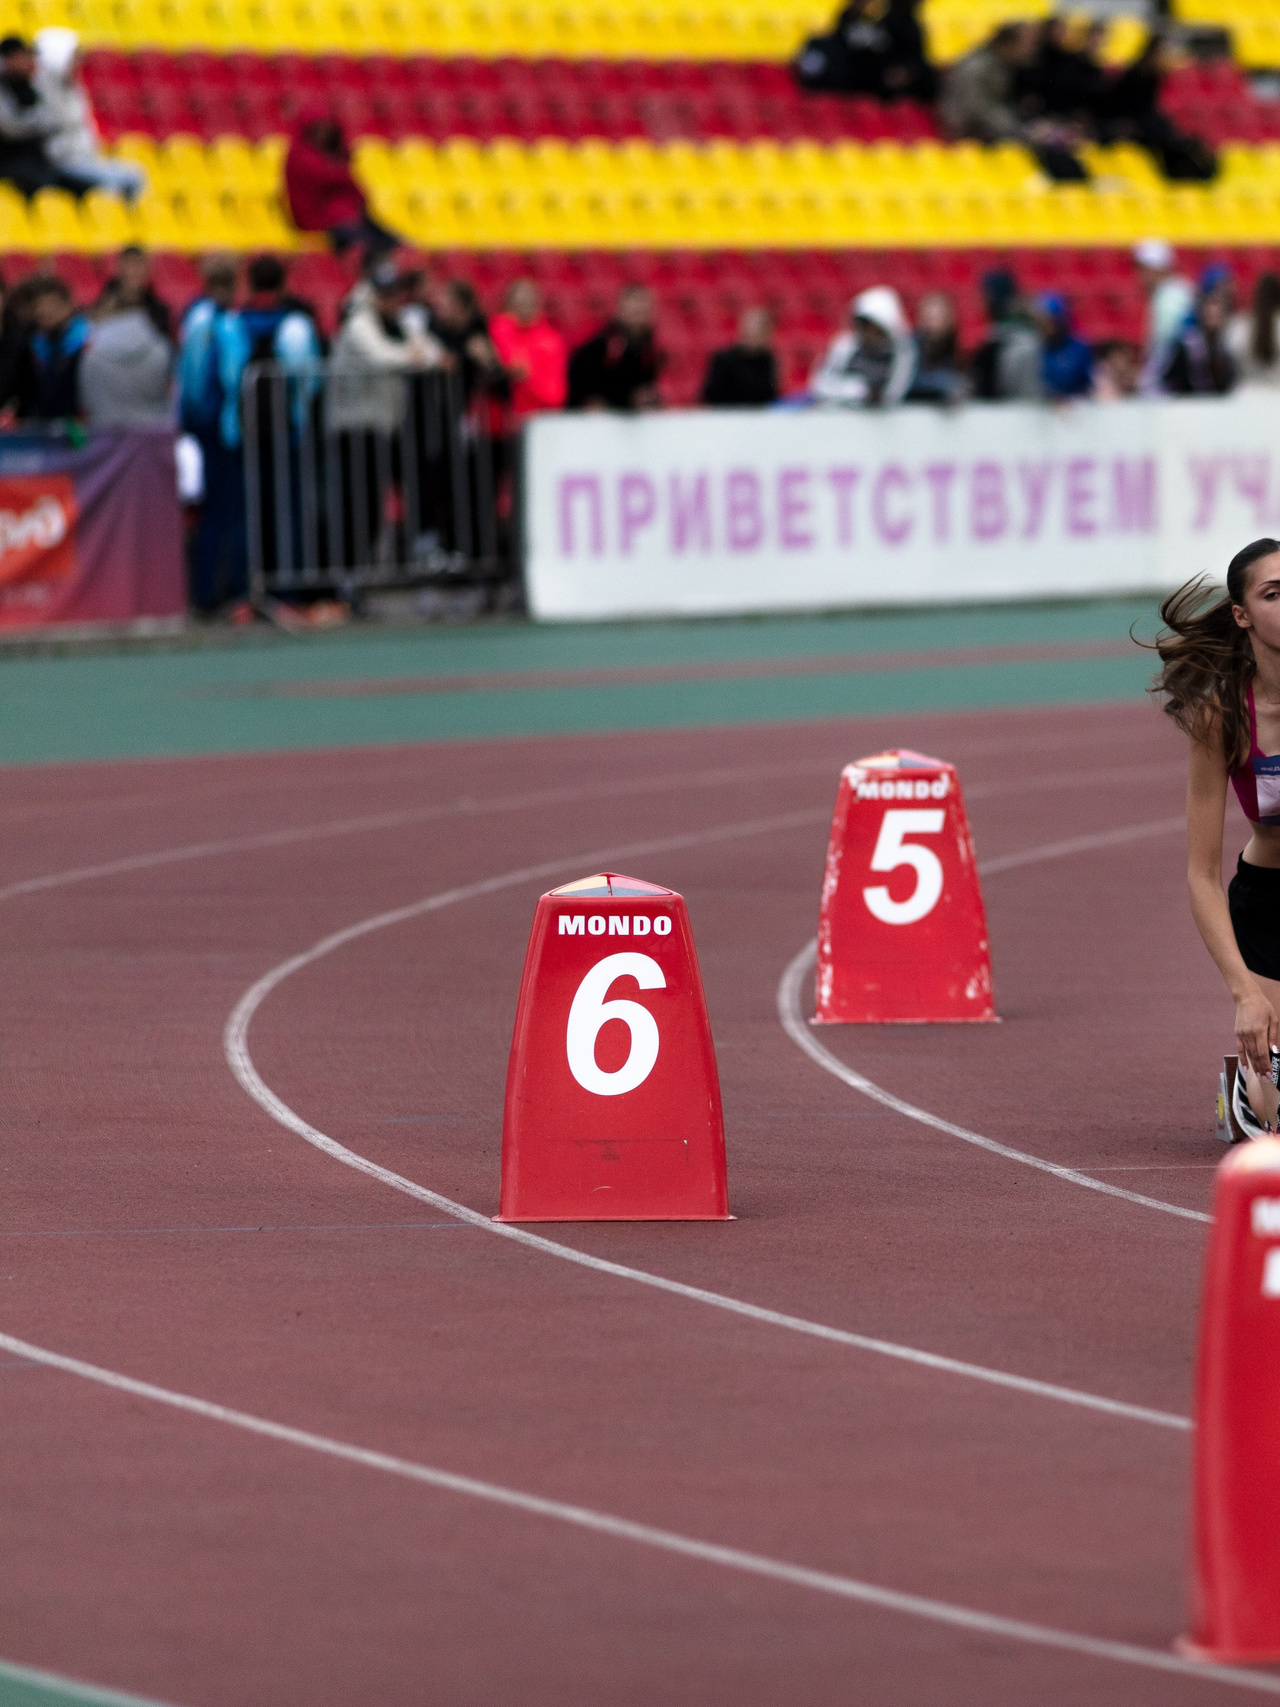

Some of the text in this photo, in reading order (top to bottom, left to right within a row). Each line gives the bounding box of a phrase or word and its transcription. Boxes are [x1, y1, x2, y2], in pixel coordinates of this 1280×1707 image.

[558, 455, 1156, 556] ПРИВЕТСТВУЕМ
[857, 779, 949, 799] MONDO
[863, 808, 945, 926] 5
[558, 915, 672, 936] MONDO
[566, 952, 667, 1096] 6
